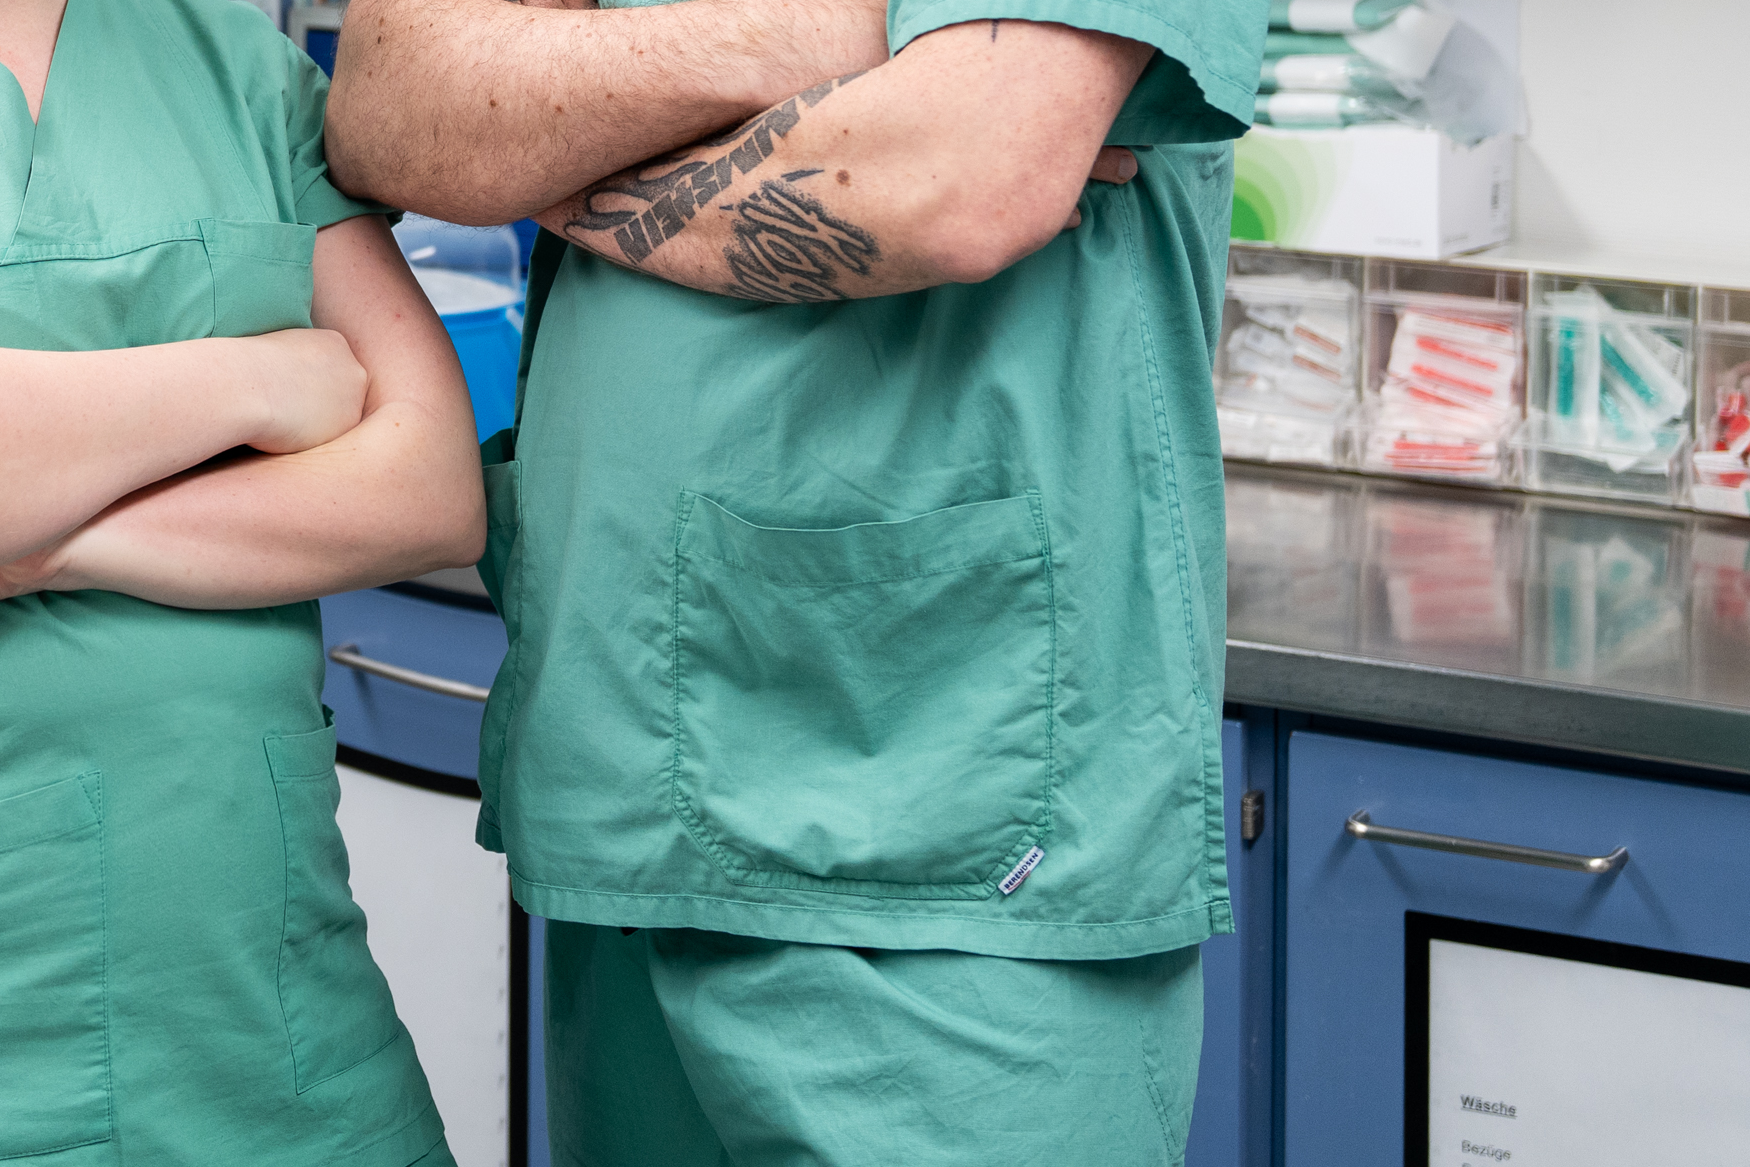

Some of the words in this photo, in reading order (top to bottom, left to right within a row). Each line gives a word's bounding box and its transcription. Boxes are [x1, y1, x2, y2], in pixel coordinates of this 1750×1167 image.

[1003, 852, 1039, 890] BERENDSEN
[1460, 1094, 1517, 1117] Wäsche
[1461, 1140, 1512, 1162] Bezüge
